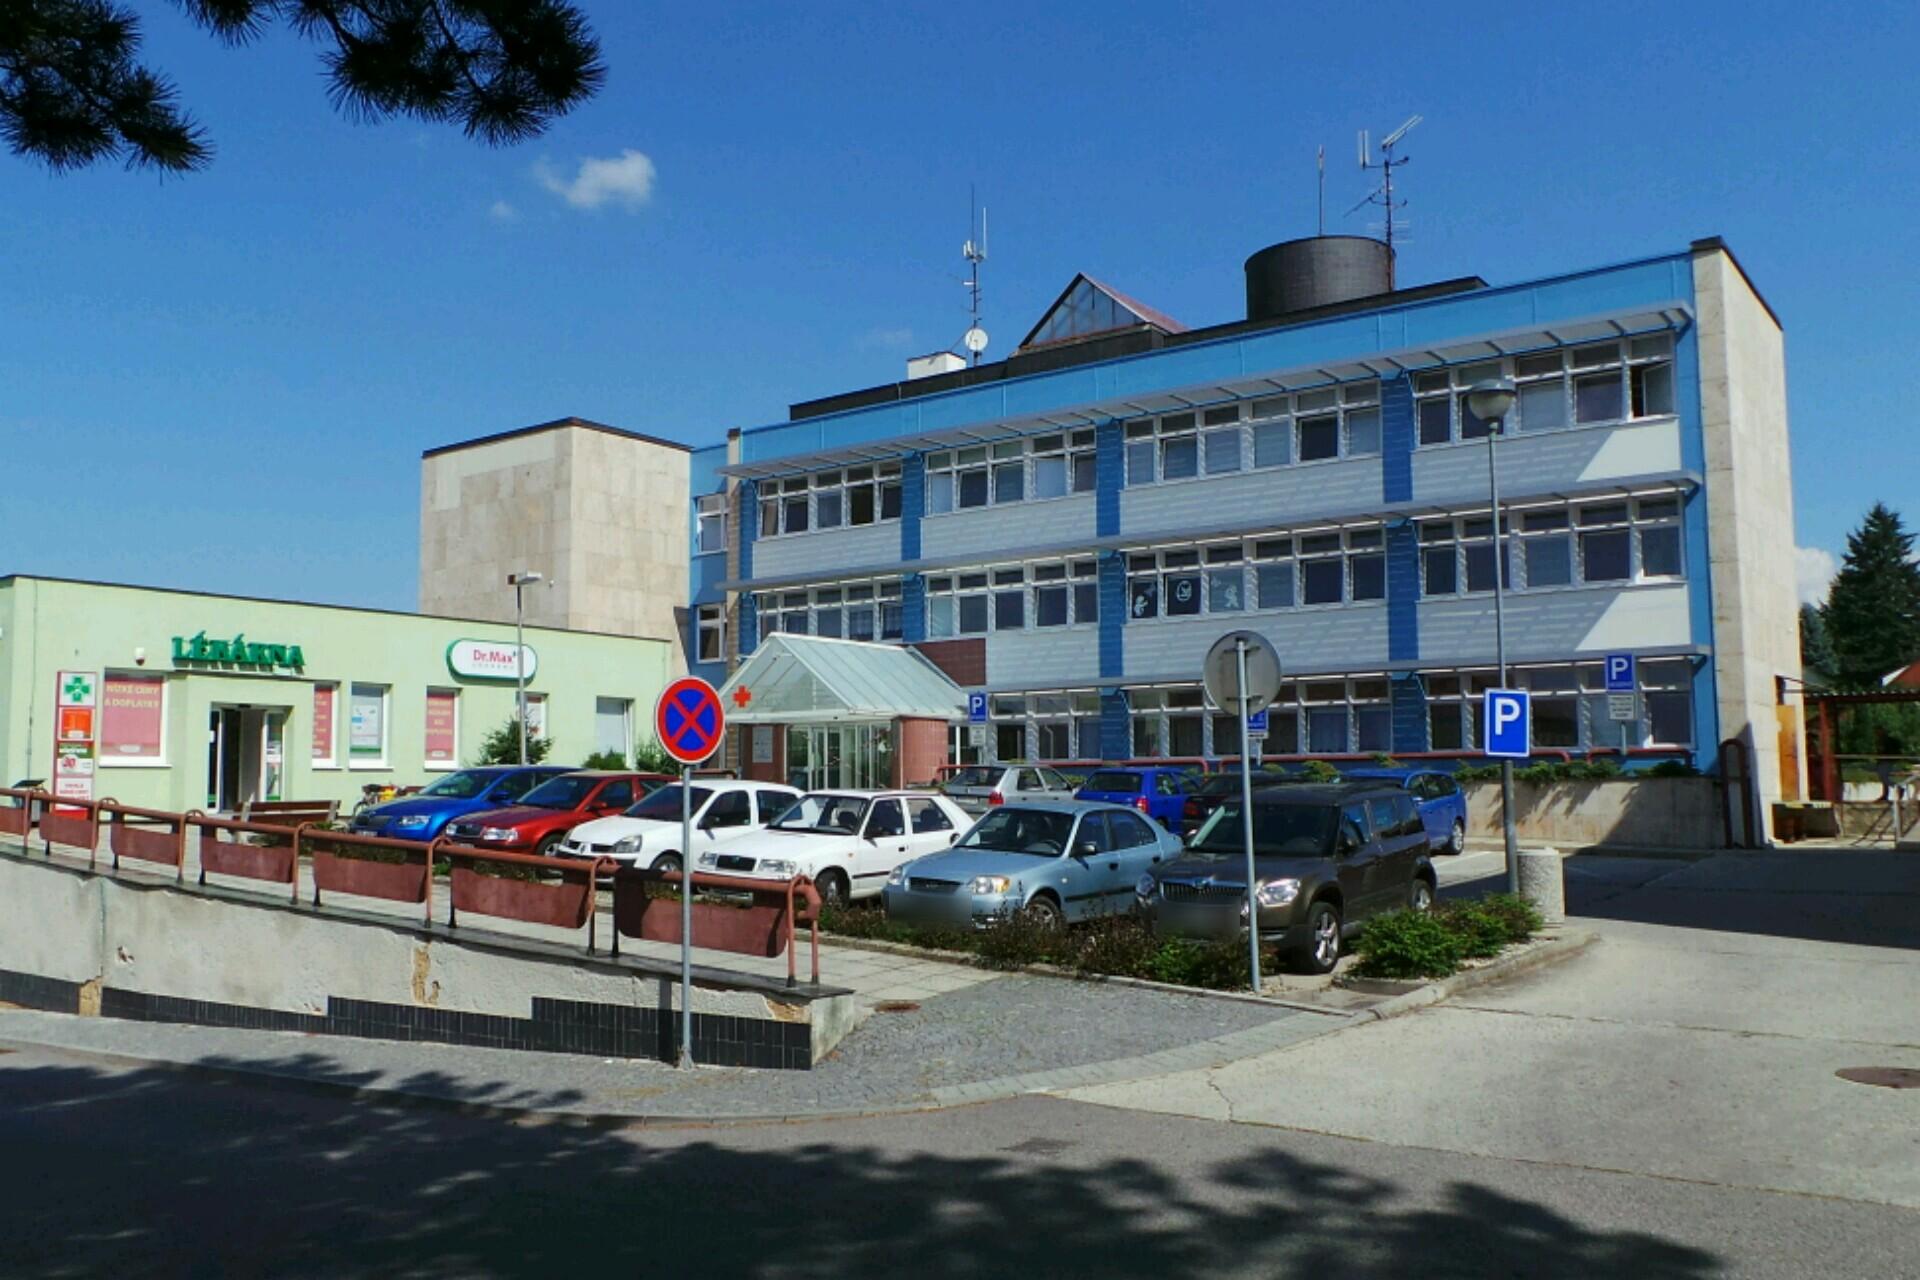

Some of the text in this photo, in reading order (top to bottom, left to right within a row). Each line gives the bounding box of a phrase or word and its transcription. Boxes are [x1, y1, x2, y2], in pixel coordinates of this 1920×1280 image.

[473, 649, 513, 663] Dr.Max
[1611, 657, 1628, 680] P
[972, 697, 983, 714] P
[1495, 697, 1520, 735] P
